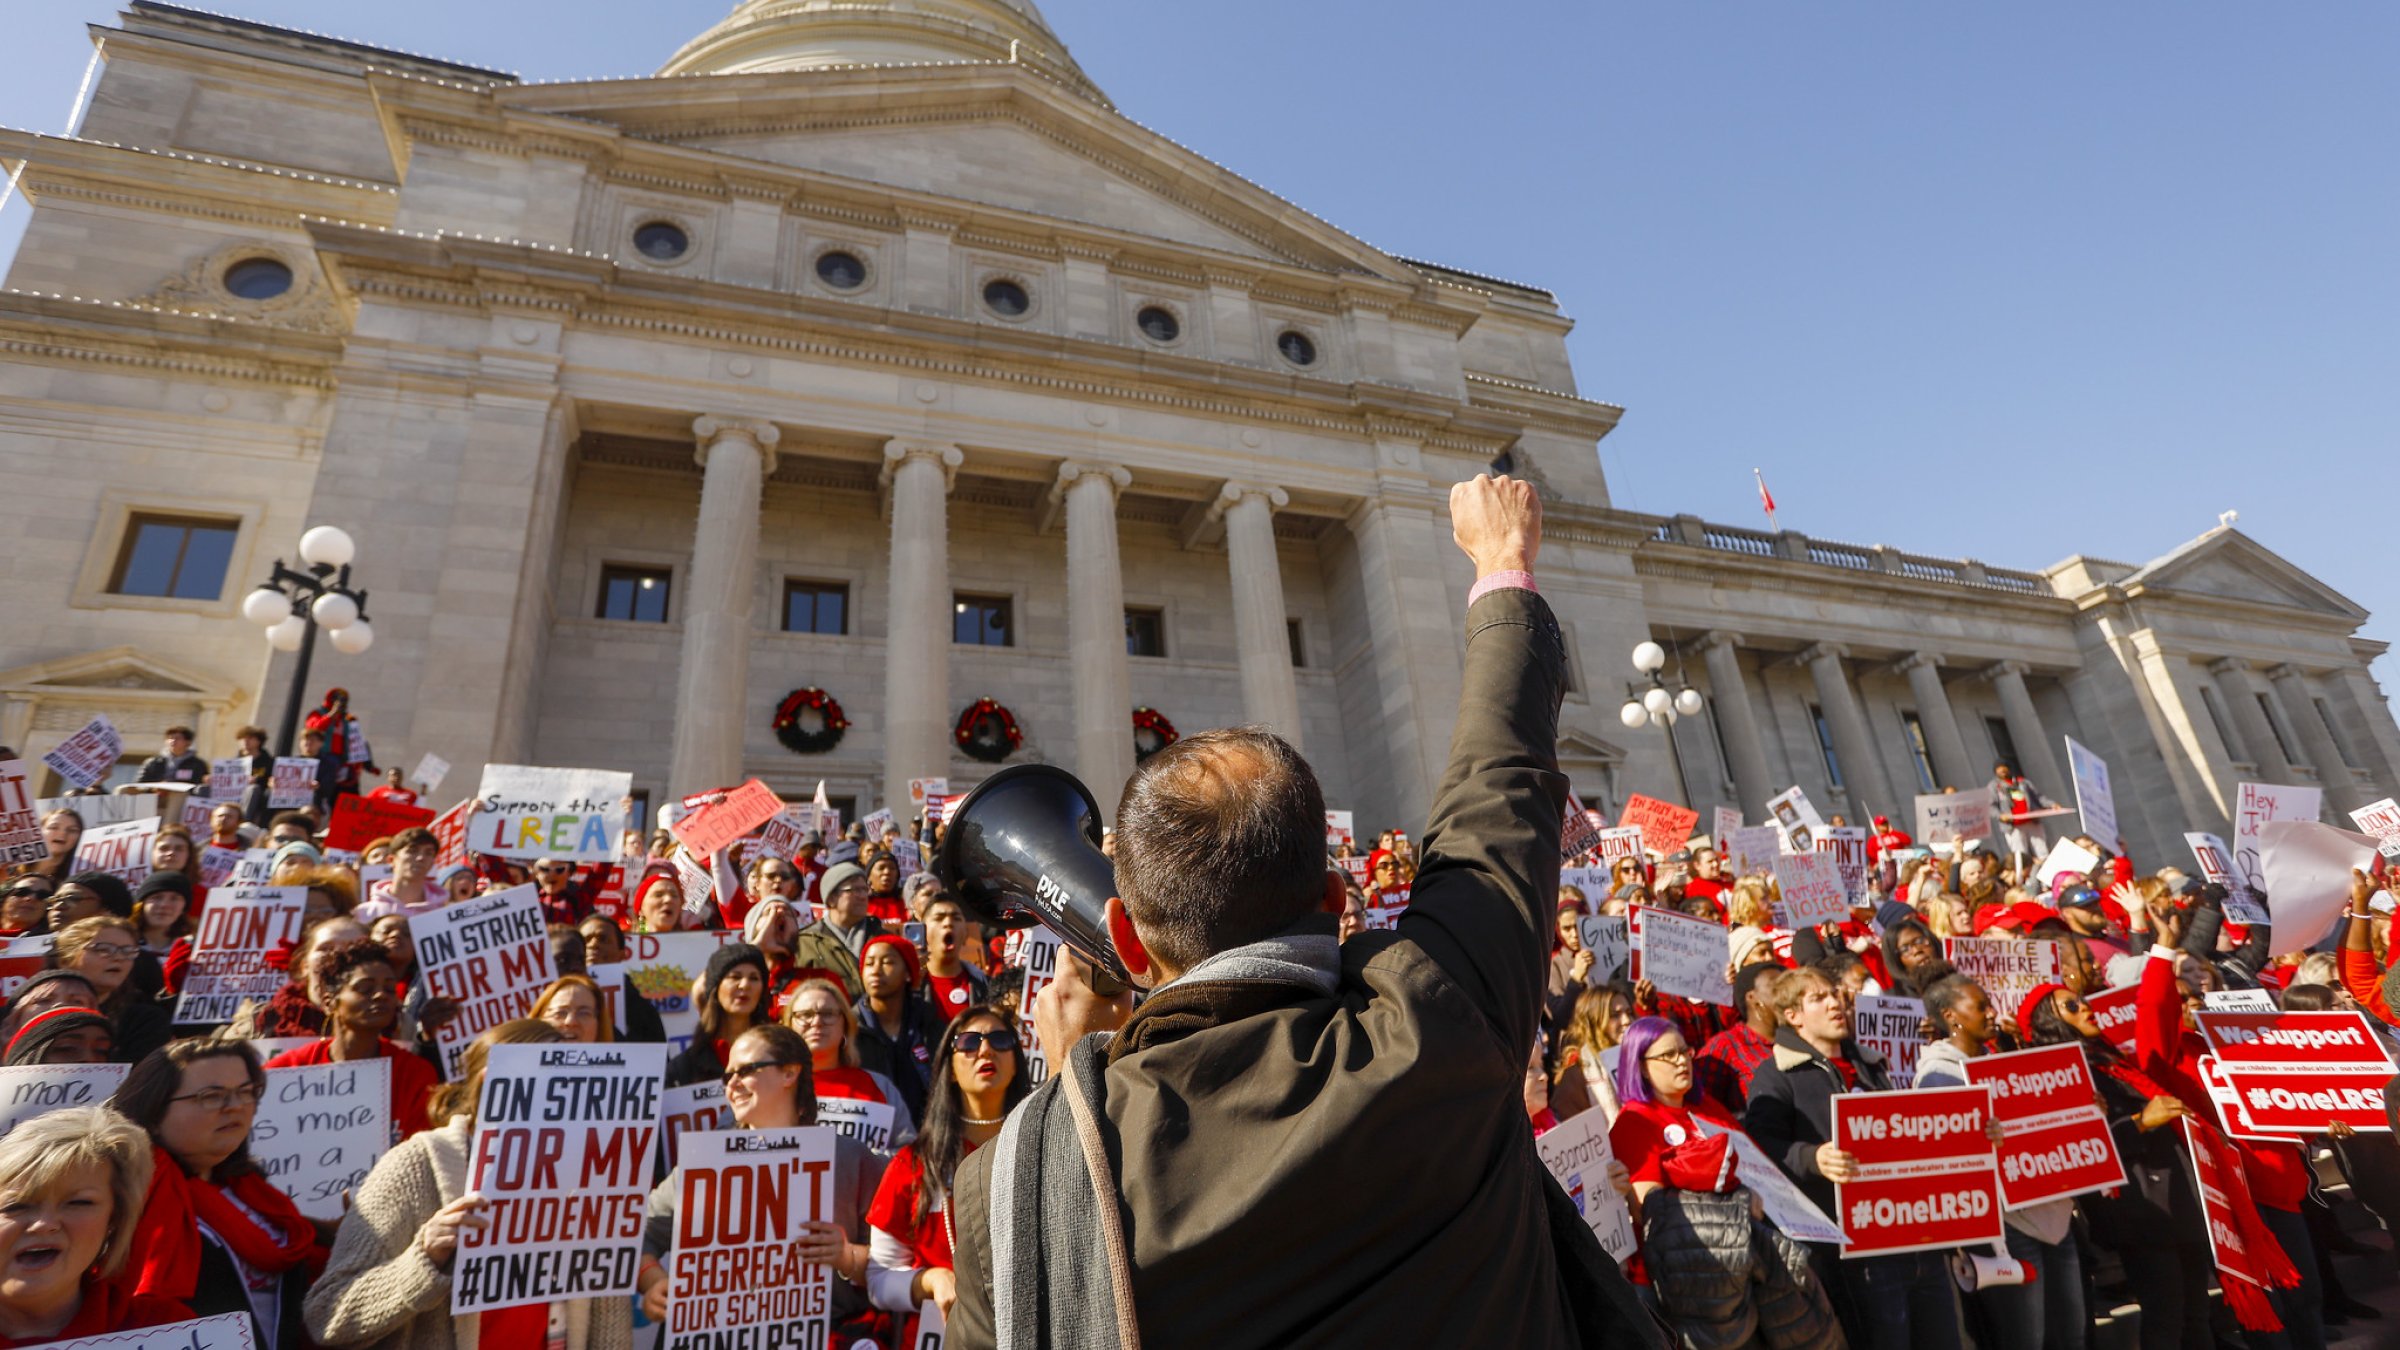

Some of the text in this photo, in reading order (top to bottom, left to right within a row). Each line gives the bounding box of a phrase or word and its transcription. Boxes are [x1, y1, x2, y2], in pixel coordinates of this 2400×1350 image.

[484, 794, 609, 815] Support the
[491, 815, 609, 853] LREA
[1561, 831, 1600, 861] NELRSD
[1600, 834, 1641, 858] DON'T
[1784, 880, 1837, 903] OUTSIDE
[1789, 893, 1845, 921] VOICES
[199, 903, 301, 950] DON'T
[420, 907, 543, 967] ON STRIKE
[1581, 918, 1628, 948] Give
[1954, 939, 2038, 957] INJUSTICE
[427, 939, 548, 1004] FOR MY
[1956, 955, 2040, 973] ANYWHERE
[186, 976, 216, 995] OUR
[1858, 1012, 1923, 1038] ON STRIK
[2214, 1025, 2365, 1050] We Support
[540, 1050, 590, 1067] LREA
[12, 1080, 93, 1105] more
[279, 1070, 356, 1104] child
[2012, 1063, 2082, 1098] Support
[484, 1076, 660, 1123] ON STRIKE
[2246, 1086, 2384, 1112] #OneLRS
[297, 1105, 376, 1134] more
[1848, 1107, 1981, 1142] We Support
[472, 1127, 653, 1192] FOR MY
[725, 1136, 768, 1153] LREA
[261, 1147, 343, 1178] an a
[2002, 1137, 2109, 1183] #OneLRSD
[679, 1157, 831, 1249] DON'T
[1851, 1190, 1990, 1229] #OneLRSD
[464, 1194, 644, 1249] STUDENTS
[459, 1246, 636, 1307] #ONELRSD
[672, 1285, 826, 1333] OUR SCHOOLS
